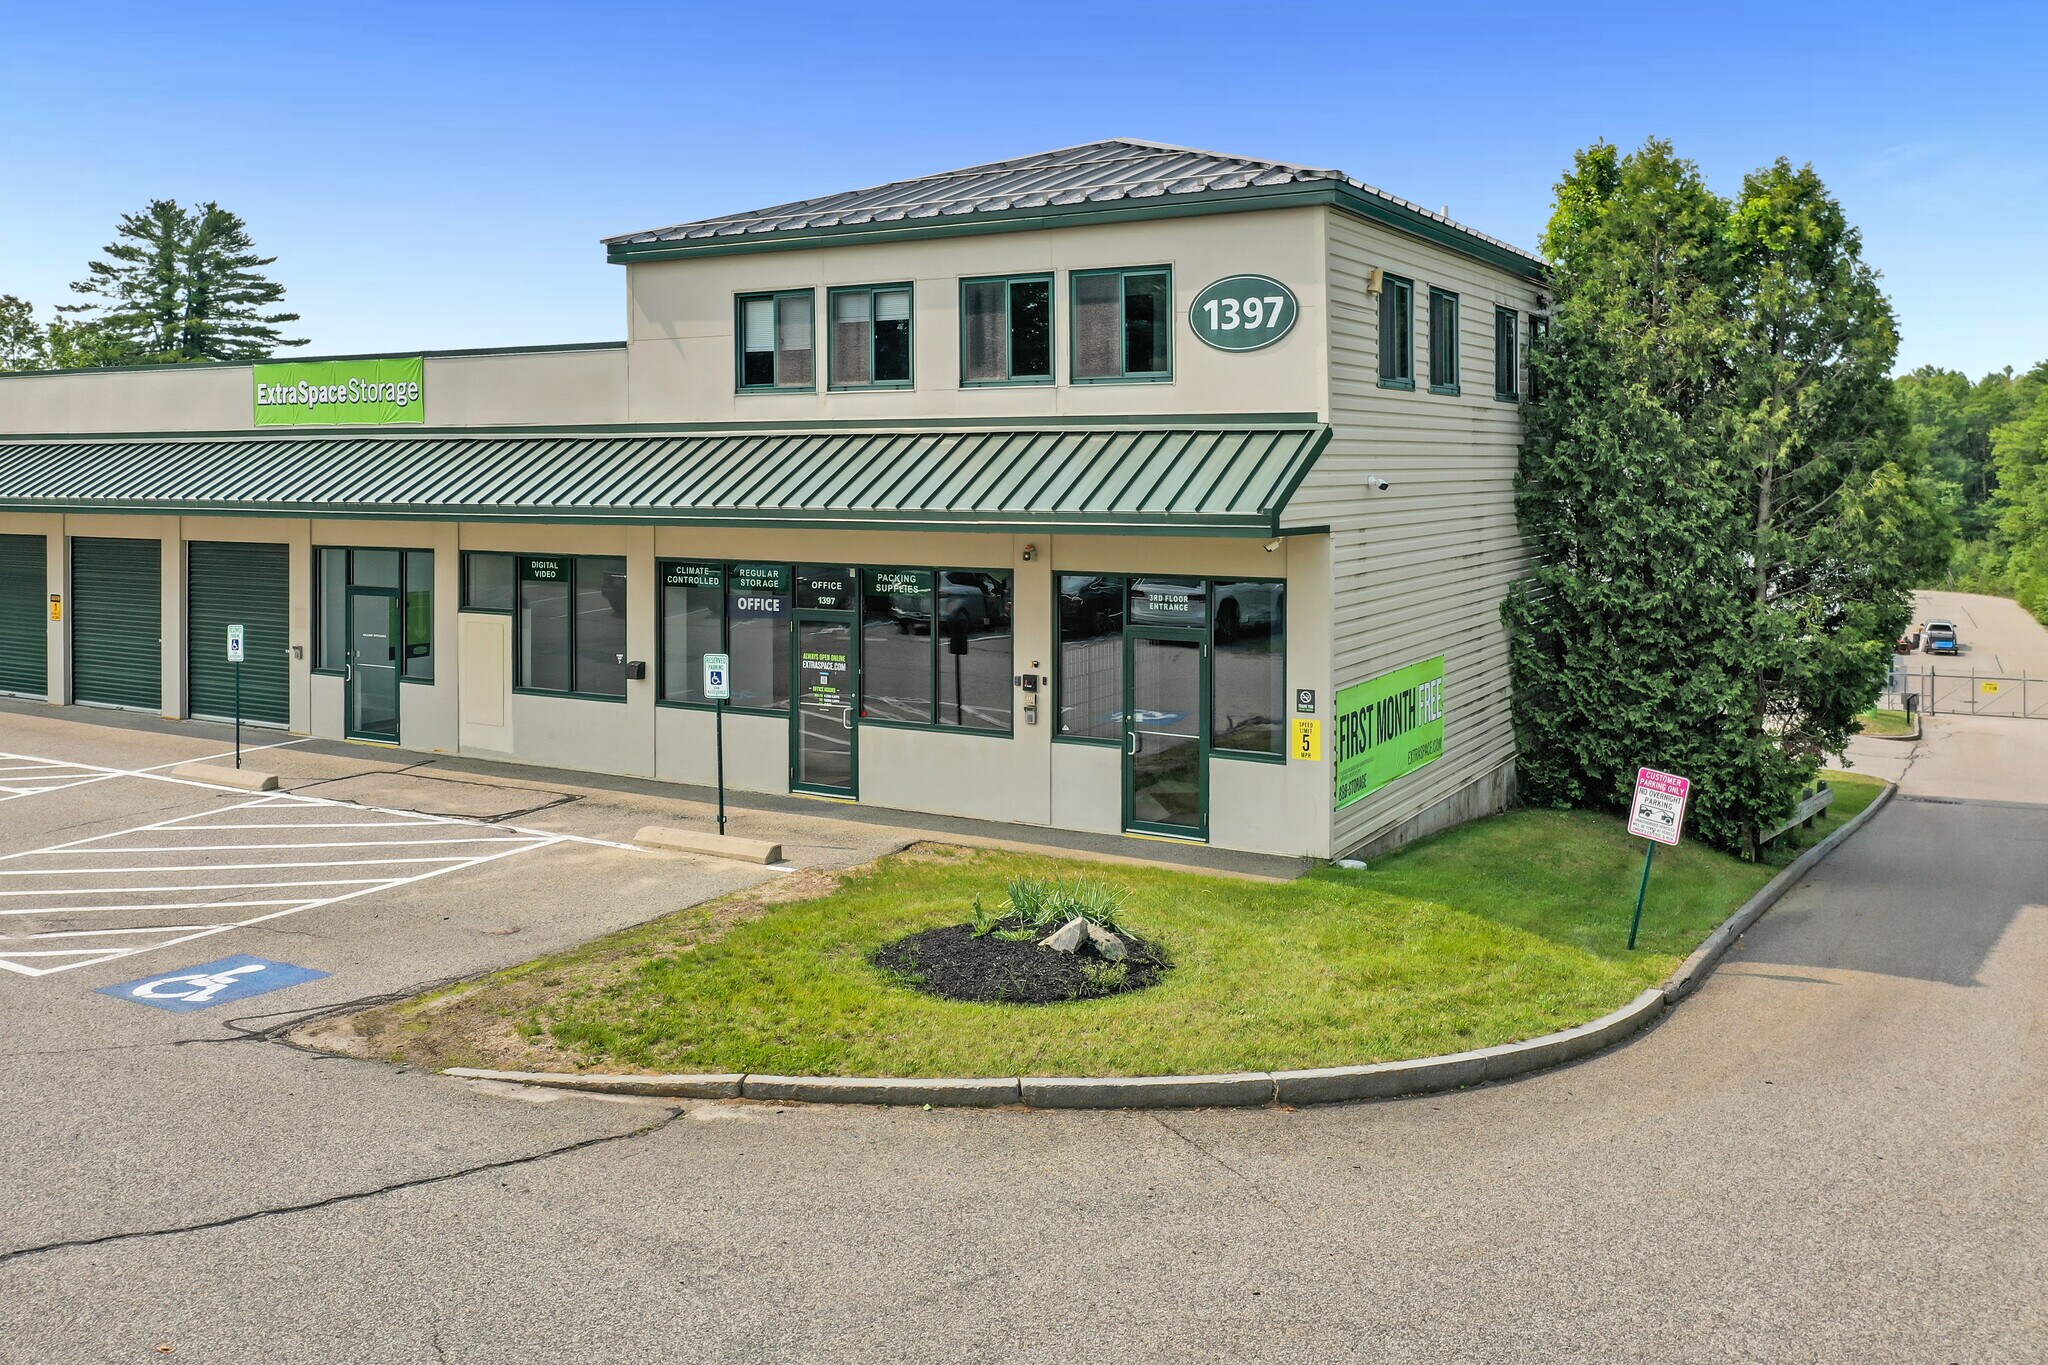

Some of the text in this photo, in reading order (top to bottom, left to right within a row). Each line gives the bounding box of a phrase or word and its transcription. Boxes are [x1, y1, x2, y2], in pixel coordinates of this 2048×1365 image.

[1203, 296, 1284, 330] 1397
[531, 561, 559, 569] DIGITAL
[534, 570, 556, 578] VIDEO
[676, 566, 710, 575] CLIMATE
[740, 569, 779, 578] REGULAR
[667, 575, 720, 585] CONTROLLED
[877, 574, 917, 583] PACKING
[740, 579, 779, 588] STORAGE
[811, 581, 842, 590] OFFICE
[817, 596, 836, 605] 1397
[1149, 594, 1189, 603] 3RD FLOOR
[737, 597, 780, 612] OFFICE
[1149, 602, 1189, 611] ENTRANCE
[819, 653, 830, 661] OPEN
[831, 654, 846, 662] ONLINE
[802, 660, 847, 671] EXTRASPACE.COM
[1339, 676, 1443, 763] FIRST MONTH FREE
[1302, 734, 1310, 751] 5
[1645, 771, 1682, 787] CUSTOMER
[1640, 778, 1685, 796] PARKING ONLY
[1639, 788, 1681, 804] NO OVERNIGHT
[1644, 797, 1673, 810] PARKING
